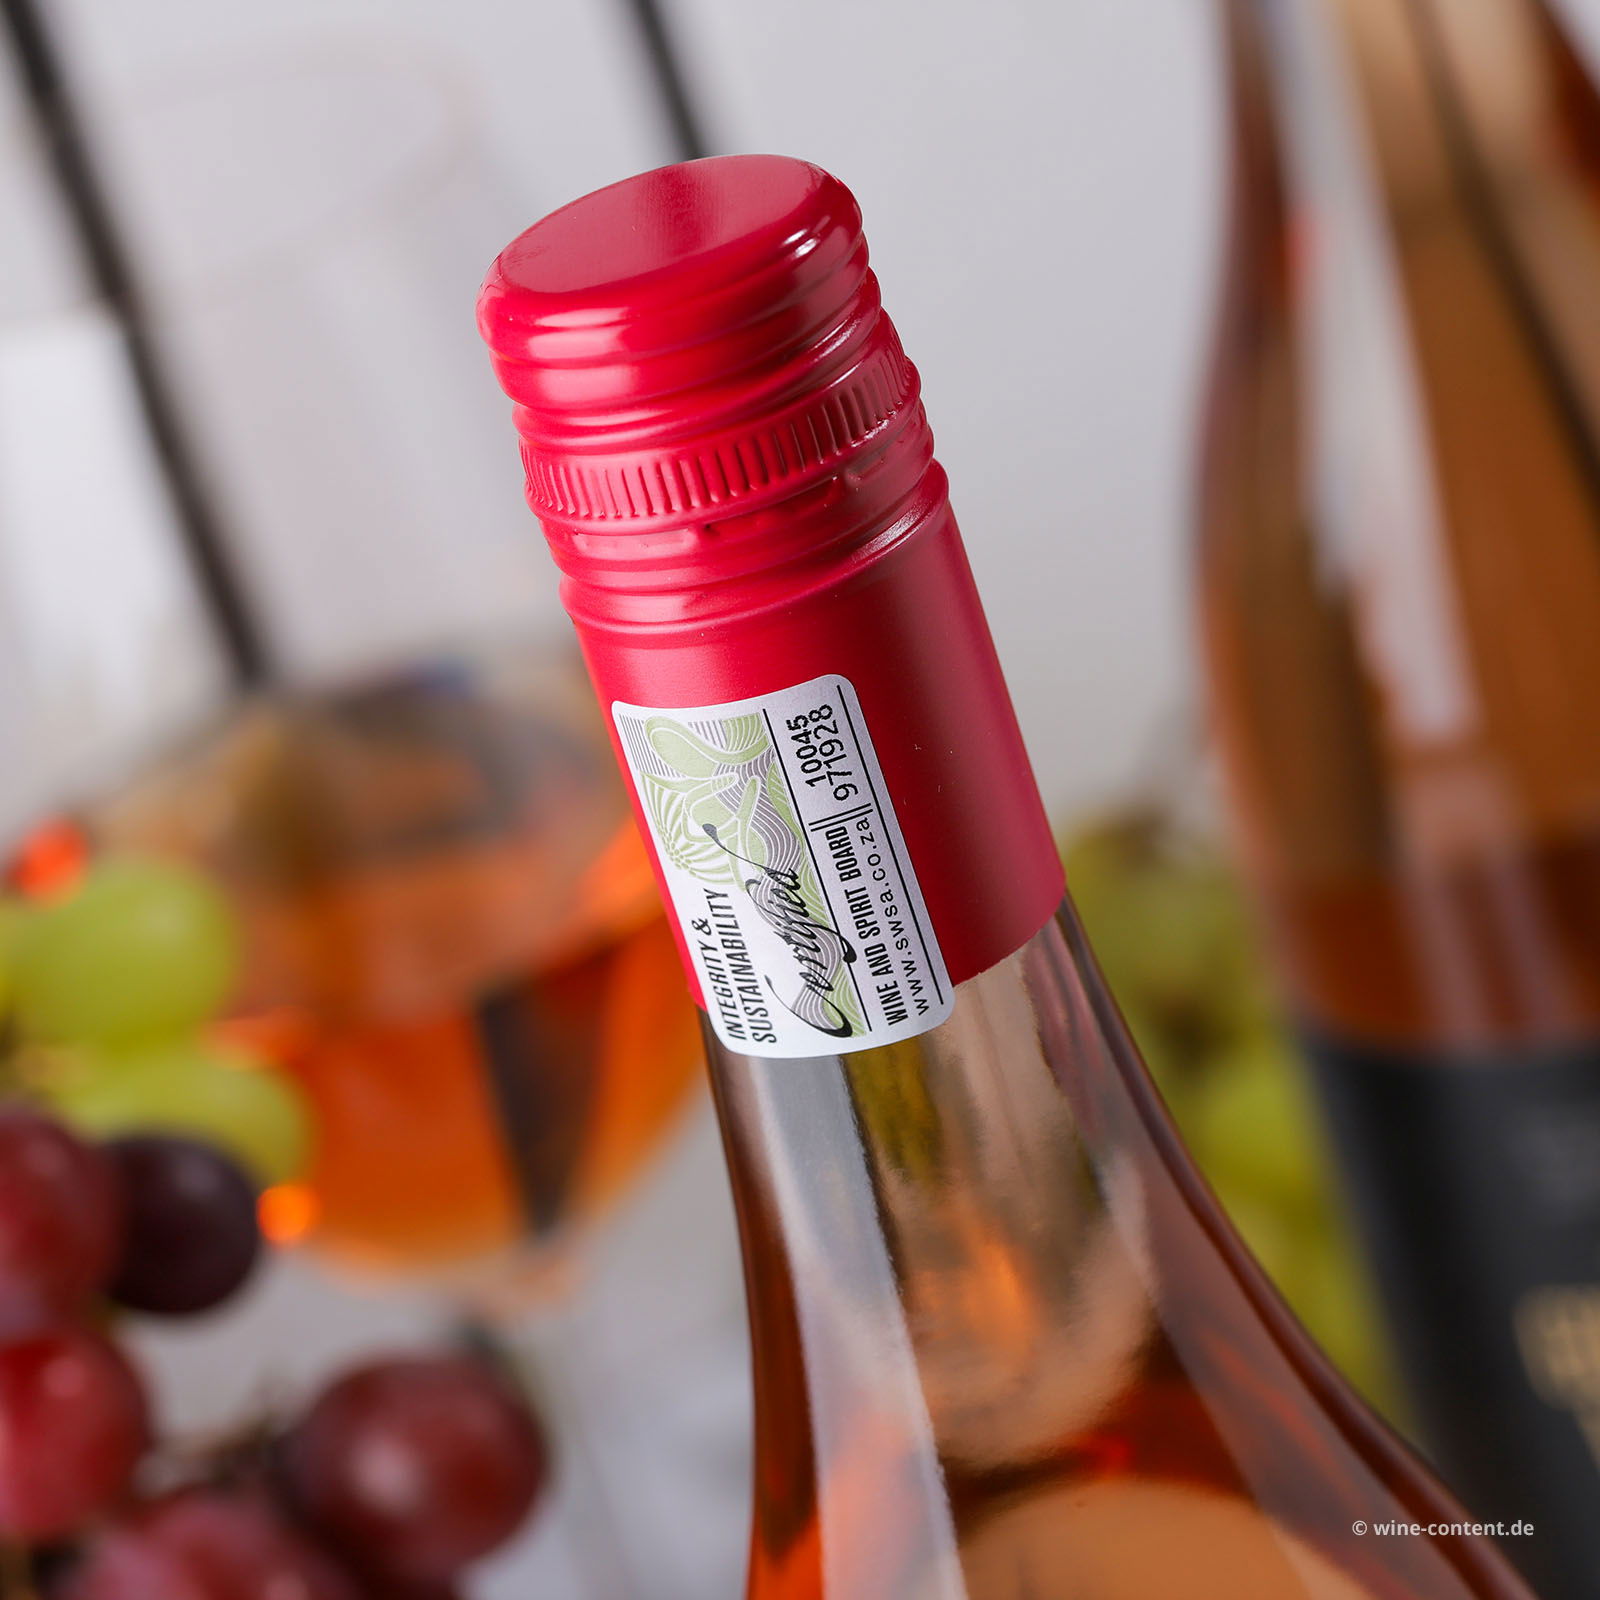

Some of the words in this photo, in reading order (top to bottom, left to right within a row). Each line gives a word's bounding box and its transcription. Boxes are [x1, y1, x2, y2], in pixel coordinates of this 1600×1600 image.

[785, 715, 826, 787] 10045
[808, 704, 858, 801] 971928
[825, 826, 862, 882] BOARD
[692, 918, 713, 937] &
[702, 823, 857, 1038] Certified
[844, 886, 881, 940] SPIRIT
[856, 817, 930, 1016] www.swsa.co.za
[700, 941, 748, 1040] INTEGRITY
[704, 888, 777, 1044] SUSTAINABILITY
[864, 943, 894, 977] AND
[876, 980, 909, 1026] WINE
